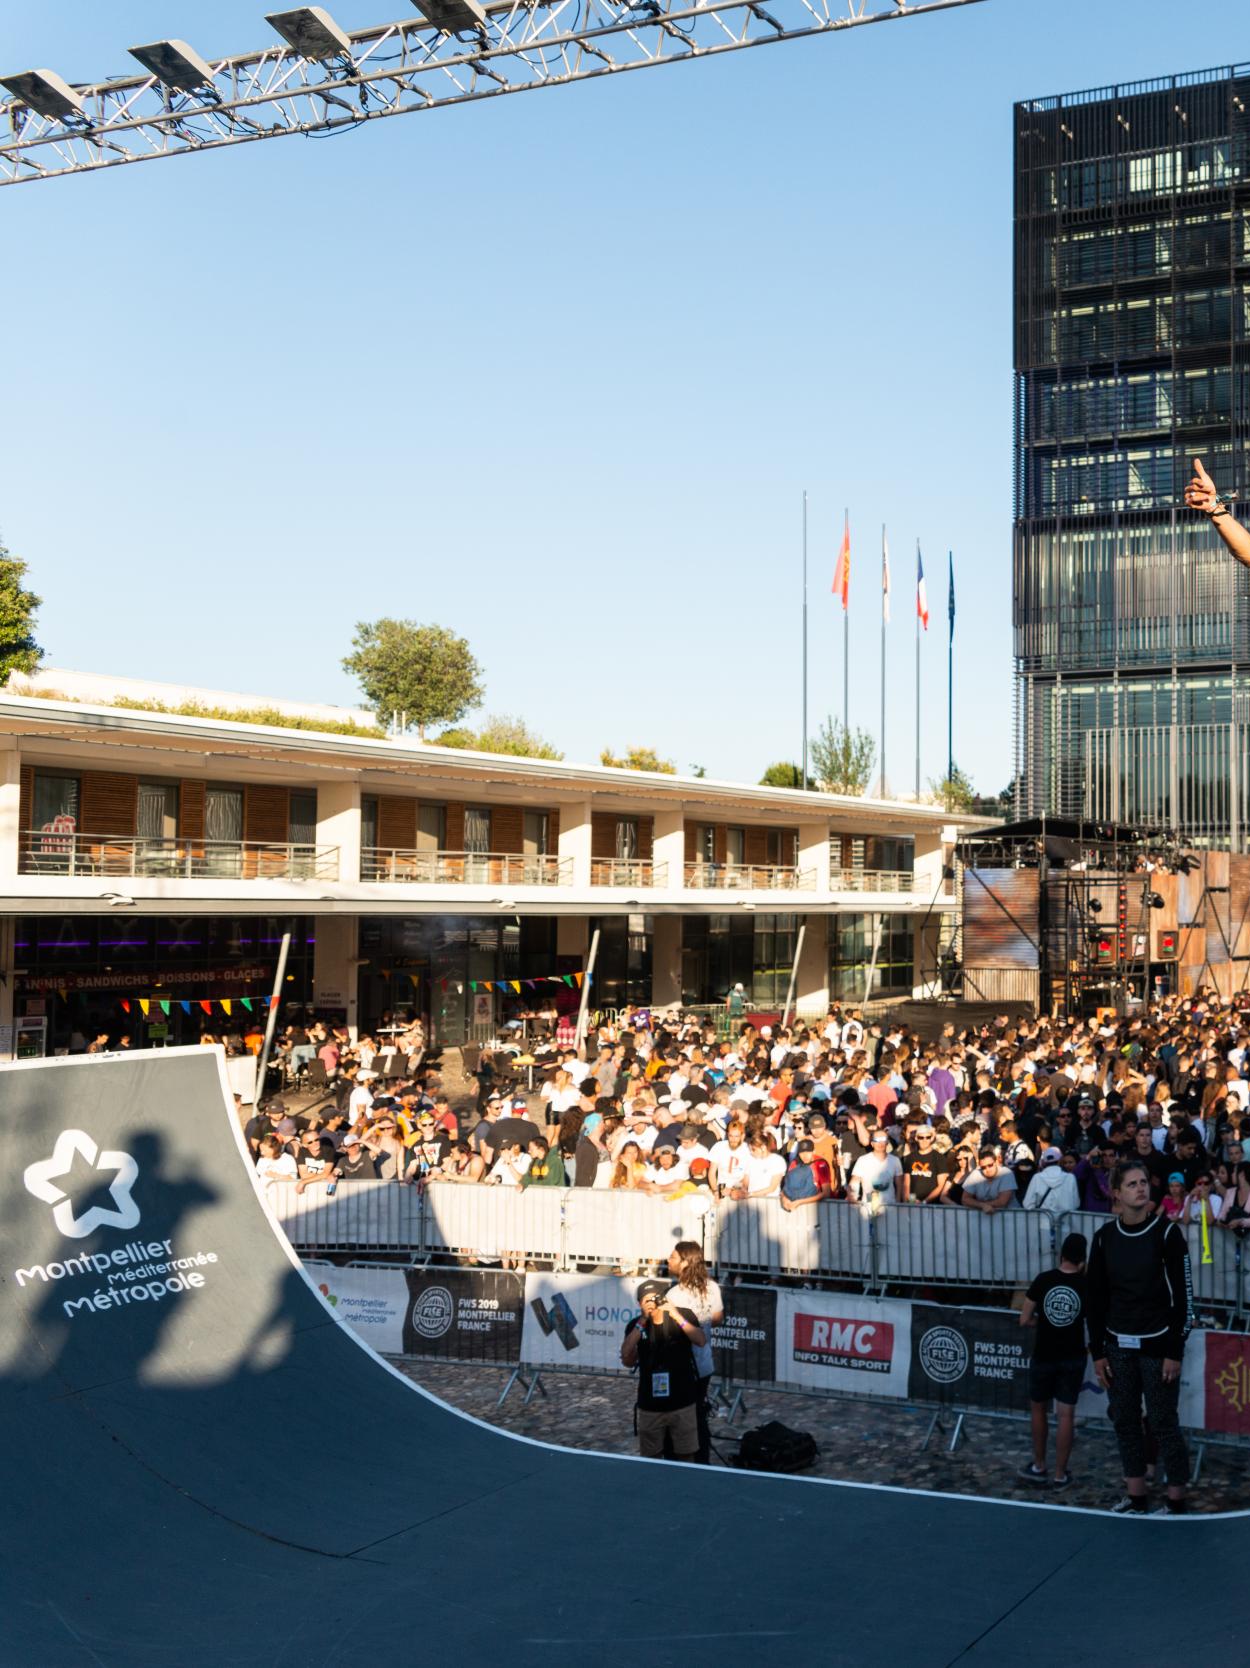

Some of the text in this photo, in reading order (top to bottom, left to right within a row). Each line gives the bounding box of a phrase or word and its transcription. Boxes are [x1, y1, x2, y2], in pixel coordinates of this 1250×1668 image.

[76, 974, 149, 988] SANDWICHS
[158, 970, 216, 984] BOISSONS
[223, 968, 265, 981] GLACES
[15, 1238, 174, 1287] Montpellier
[107, 1251, 219, 1285] Méditerranée
[63, 1271, 207, 1318] Métropole
[458, 1298, 500, 1310] FWS 2019
[457, 1309, 516, 1322] MONTPELLIER
[726, 1315, 748, 1328] 2019
[457, 1320, 492, 1332] FRANCE
[710, 1337, 739, 1351] RANCE
[811, 1319, 875, 1355] RMC
[974, 1341, 1023, 1357] FWS 2019
[795, 1351, 891, 1373] INFO TALK SPORT
[974, 1353, 1031, 1369] MONTPELLI
[974, 1365, 1015, 1380] FRANCE
